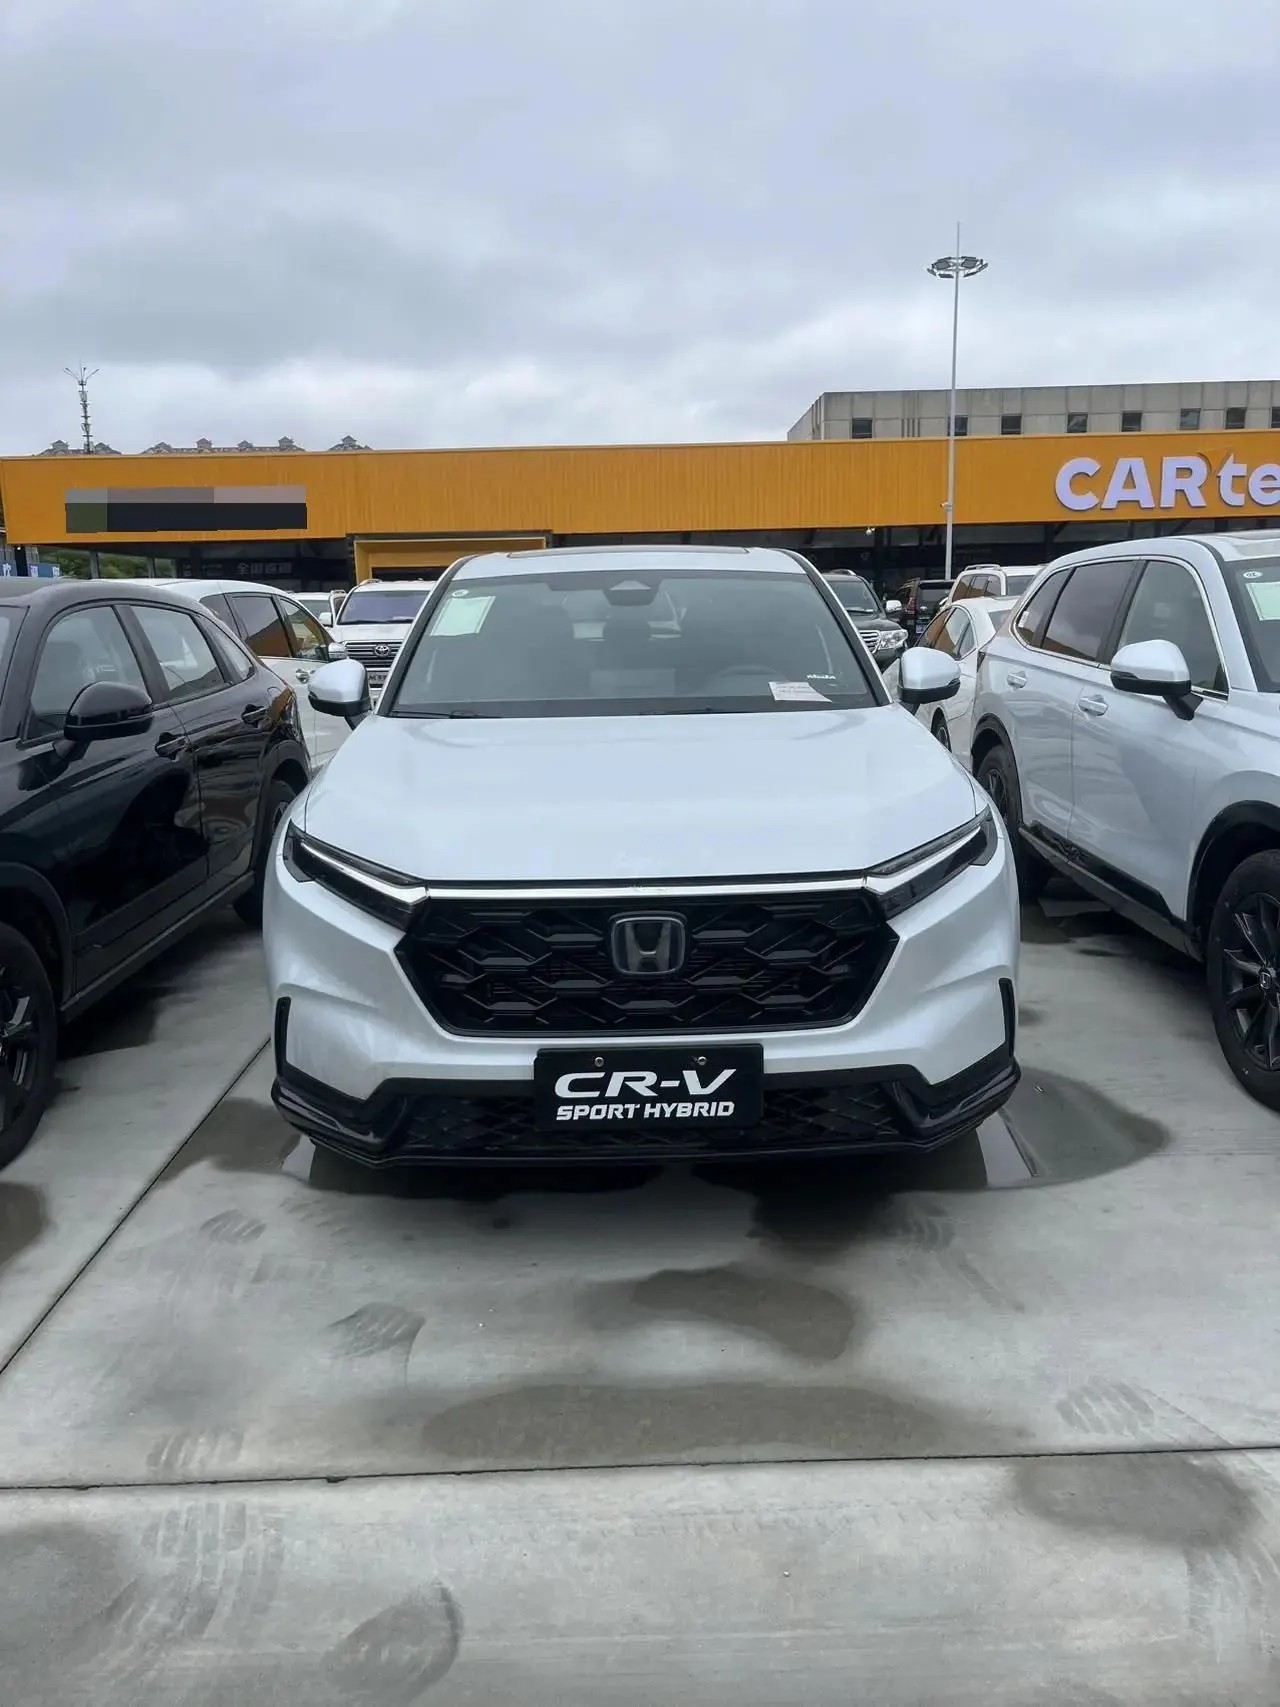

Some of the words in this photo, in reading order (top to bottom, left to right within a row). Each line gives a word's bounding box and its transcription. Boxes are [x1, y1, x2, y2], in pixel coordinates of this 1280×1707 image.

[554, 1068, 737, 1098] CR-V
[556, 1103, 641, 1121] SPORT
[643, 1101, 735, 1119] HYBRID
